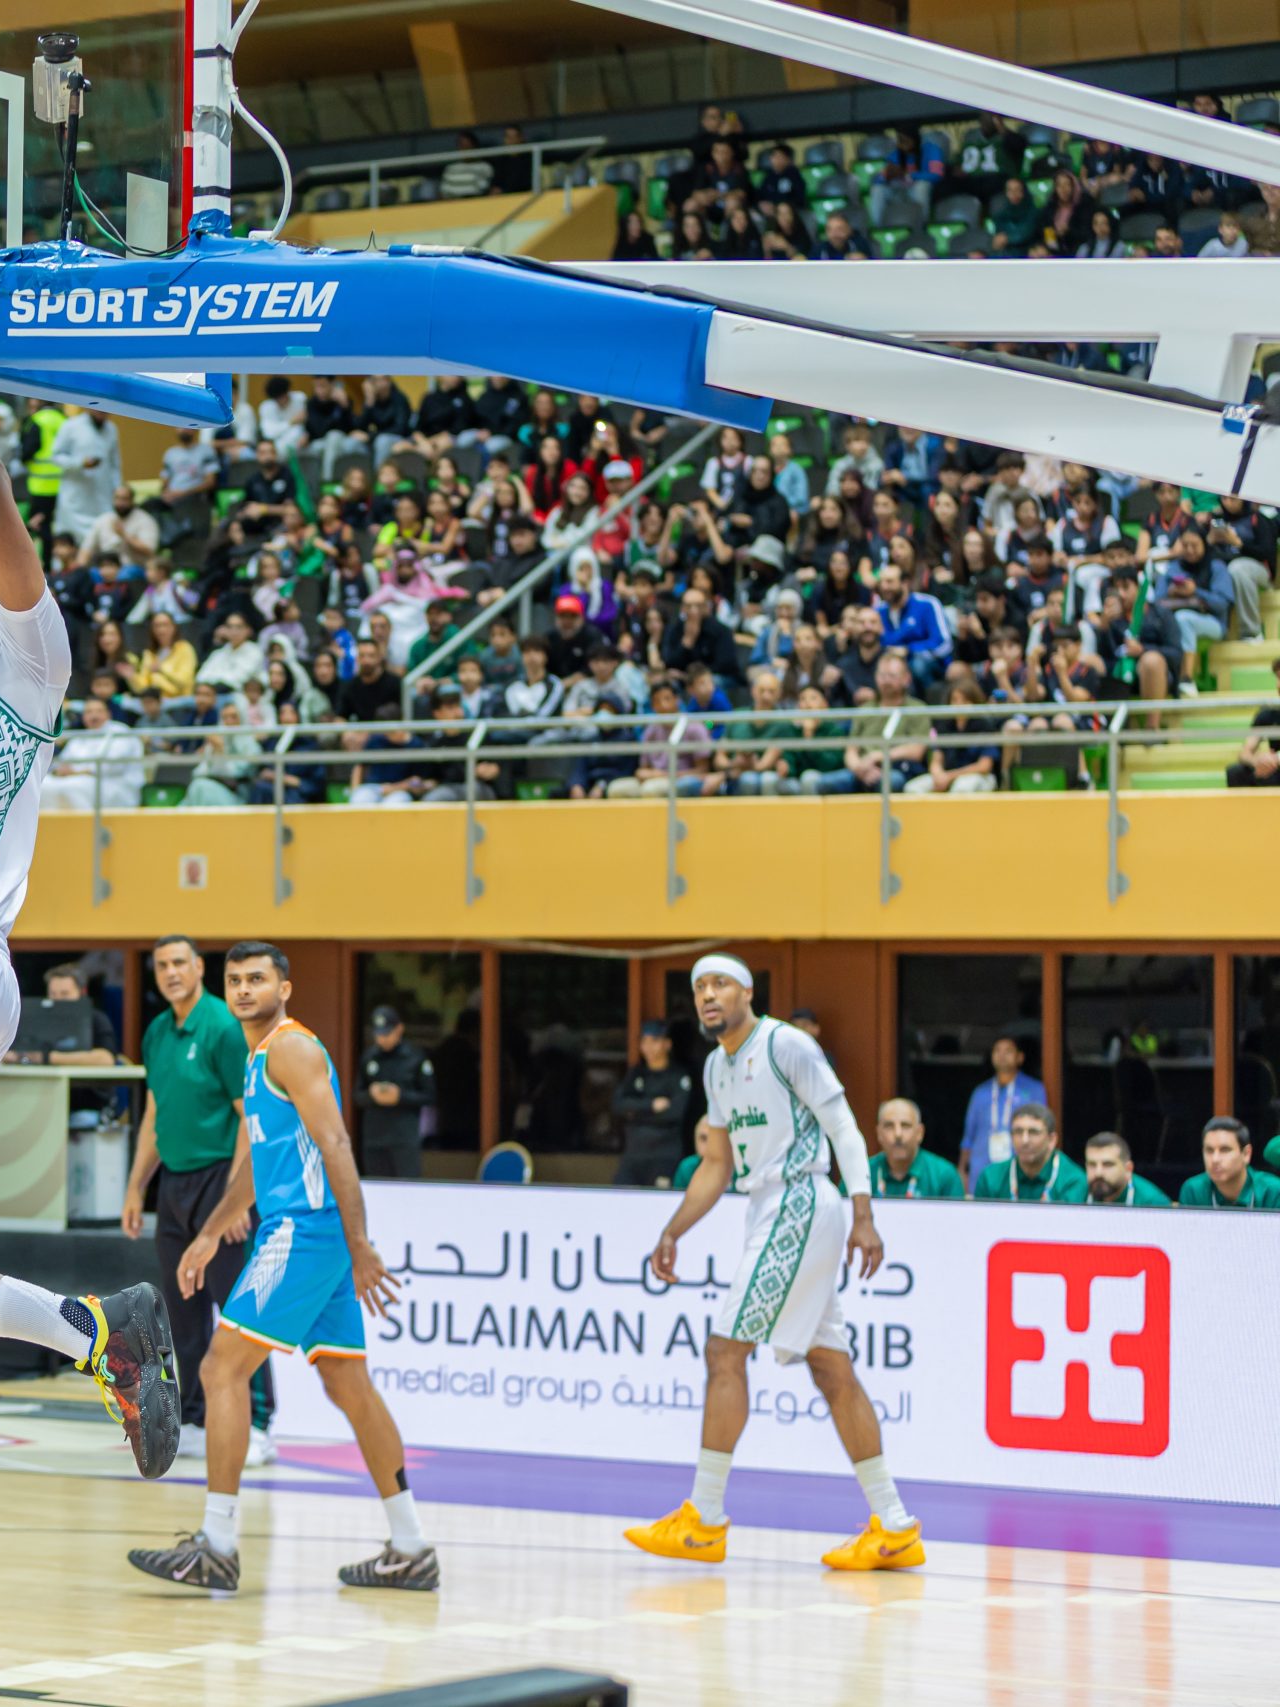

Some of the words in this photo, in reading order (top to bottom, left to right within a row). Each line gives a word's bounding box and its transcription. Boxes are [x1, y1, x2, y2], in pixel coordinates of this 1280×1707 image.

[9, 287, 149, 323] SPORT
[153, 281, 339, 325] SYSTEM
[378, 1299, 645, 1356] SULAIMAN
[370, 1365, 495, 1398] medical
[502, 1373, 603, 1411] group
